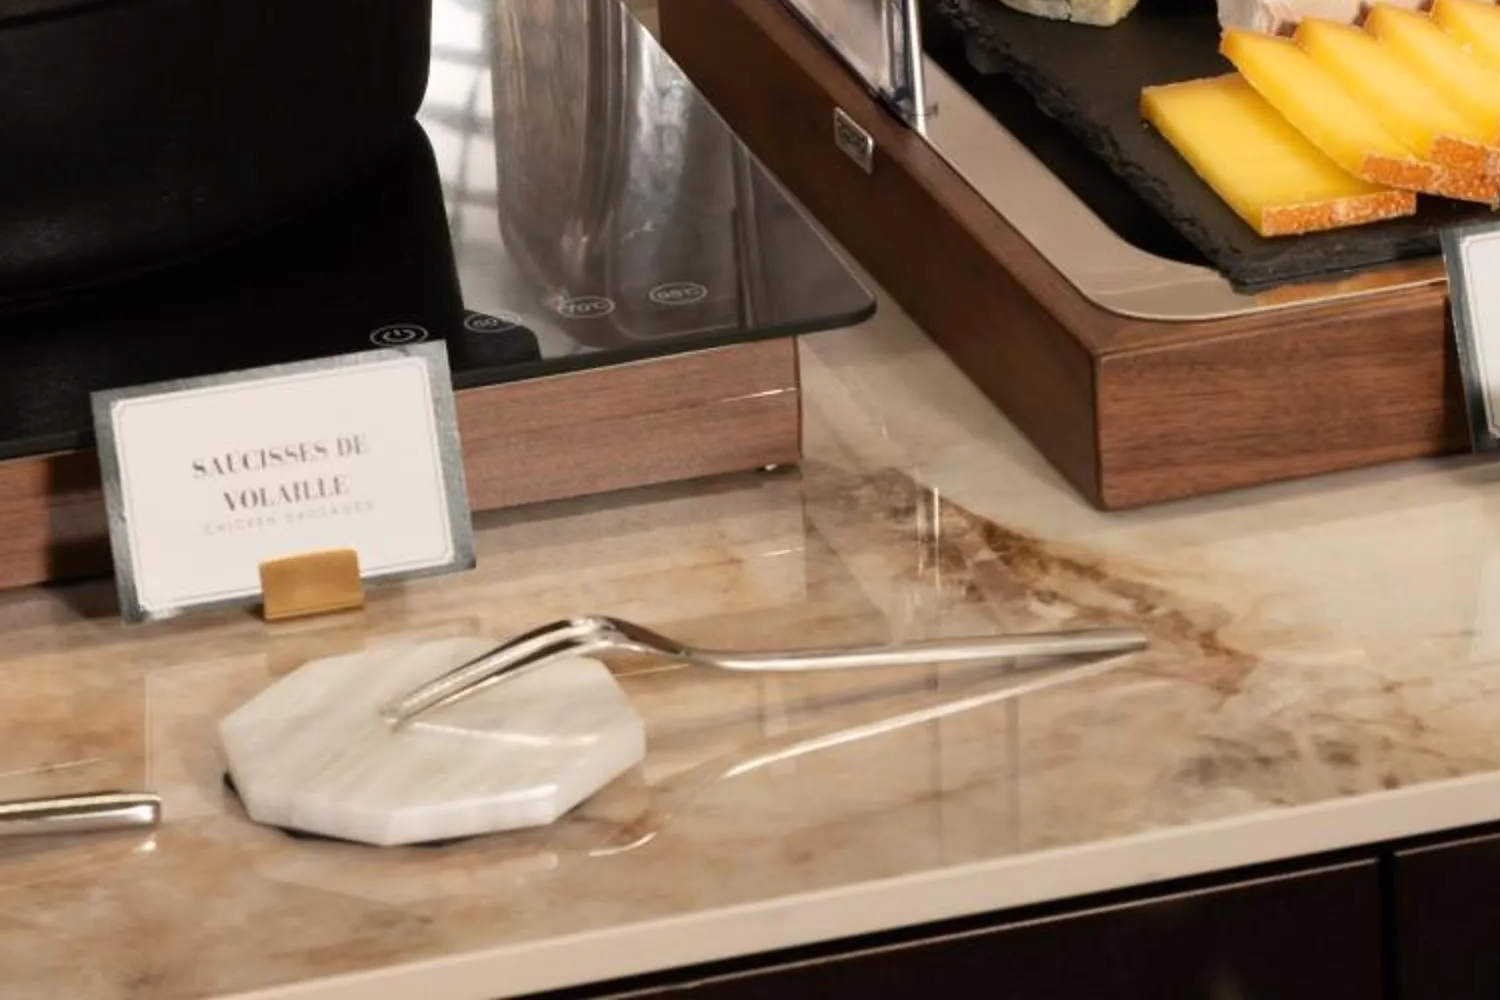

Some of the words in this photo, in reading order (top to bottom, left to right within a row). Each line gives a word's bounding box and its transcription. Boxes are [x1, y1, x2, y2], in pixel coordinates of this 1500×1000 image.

[192, 442, 330, 479] SAUCISSES
[336, 432, 370, 457] DE
[224, 473, 350, 512] VOLAILLE
